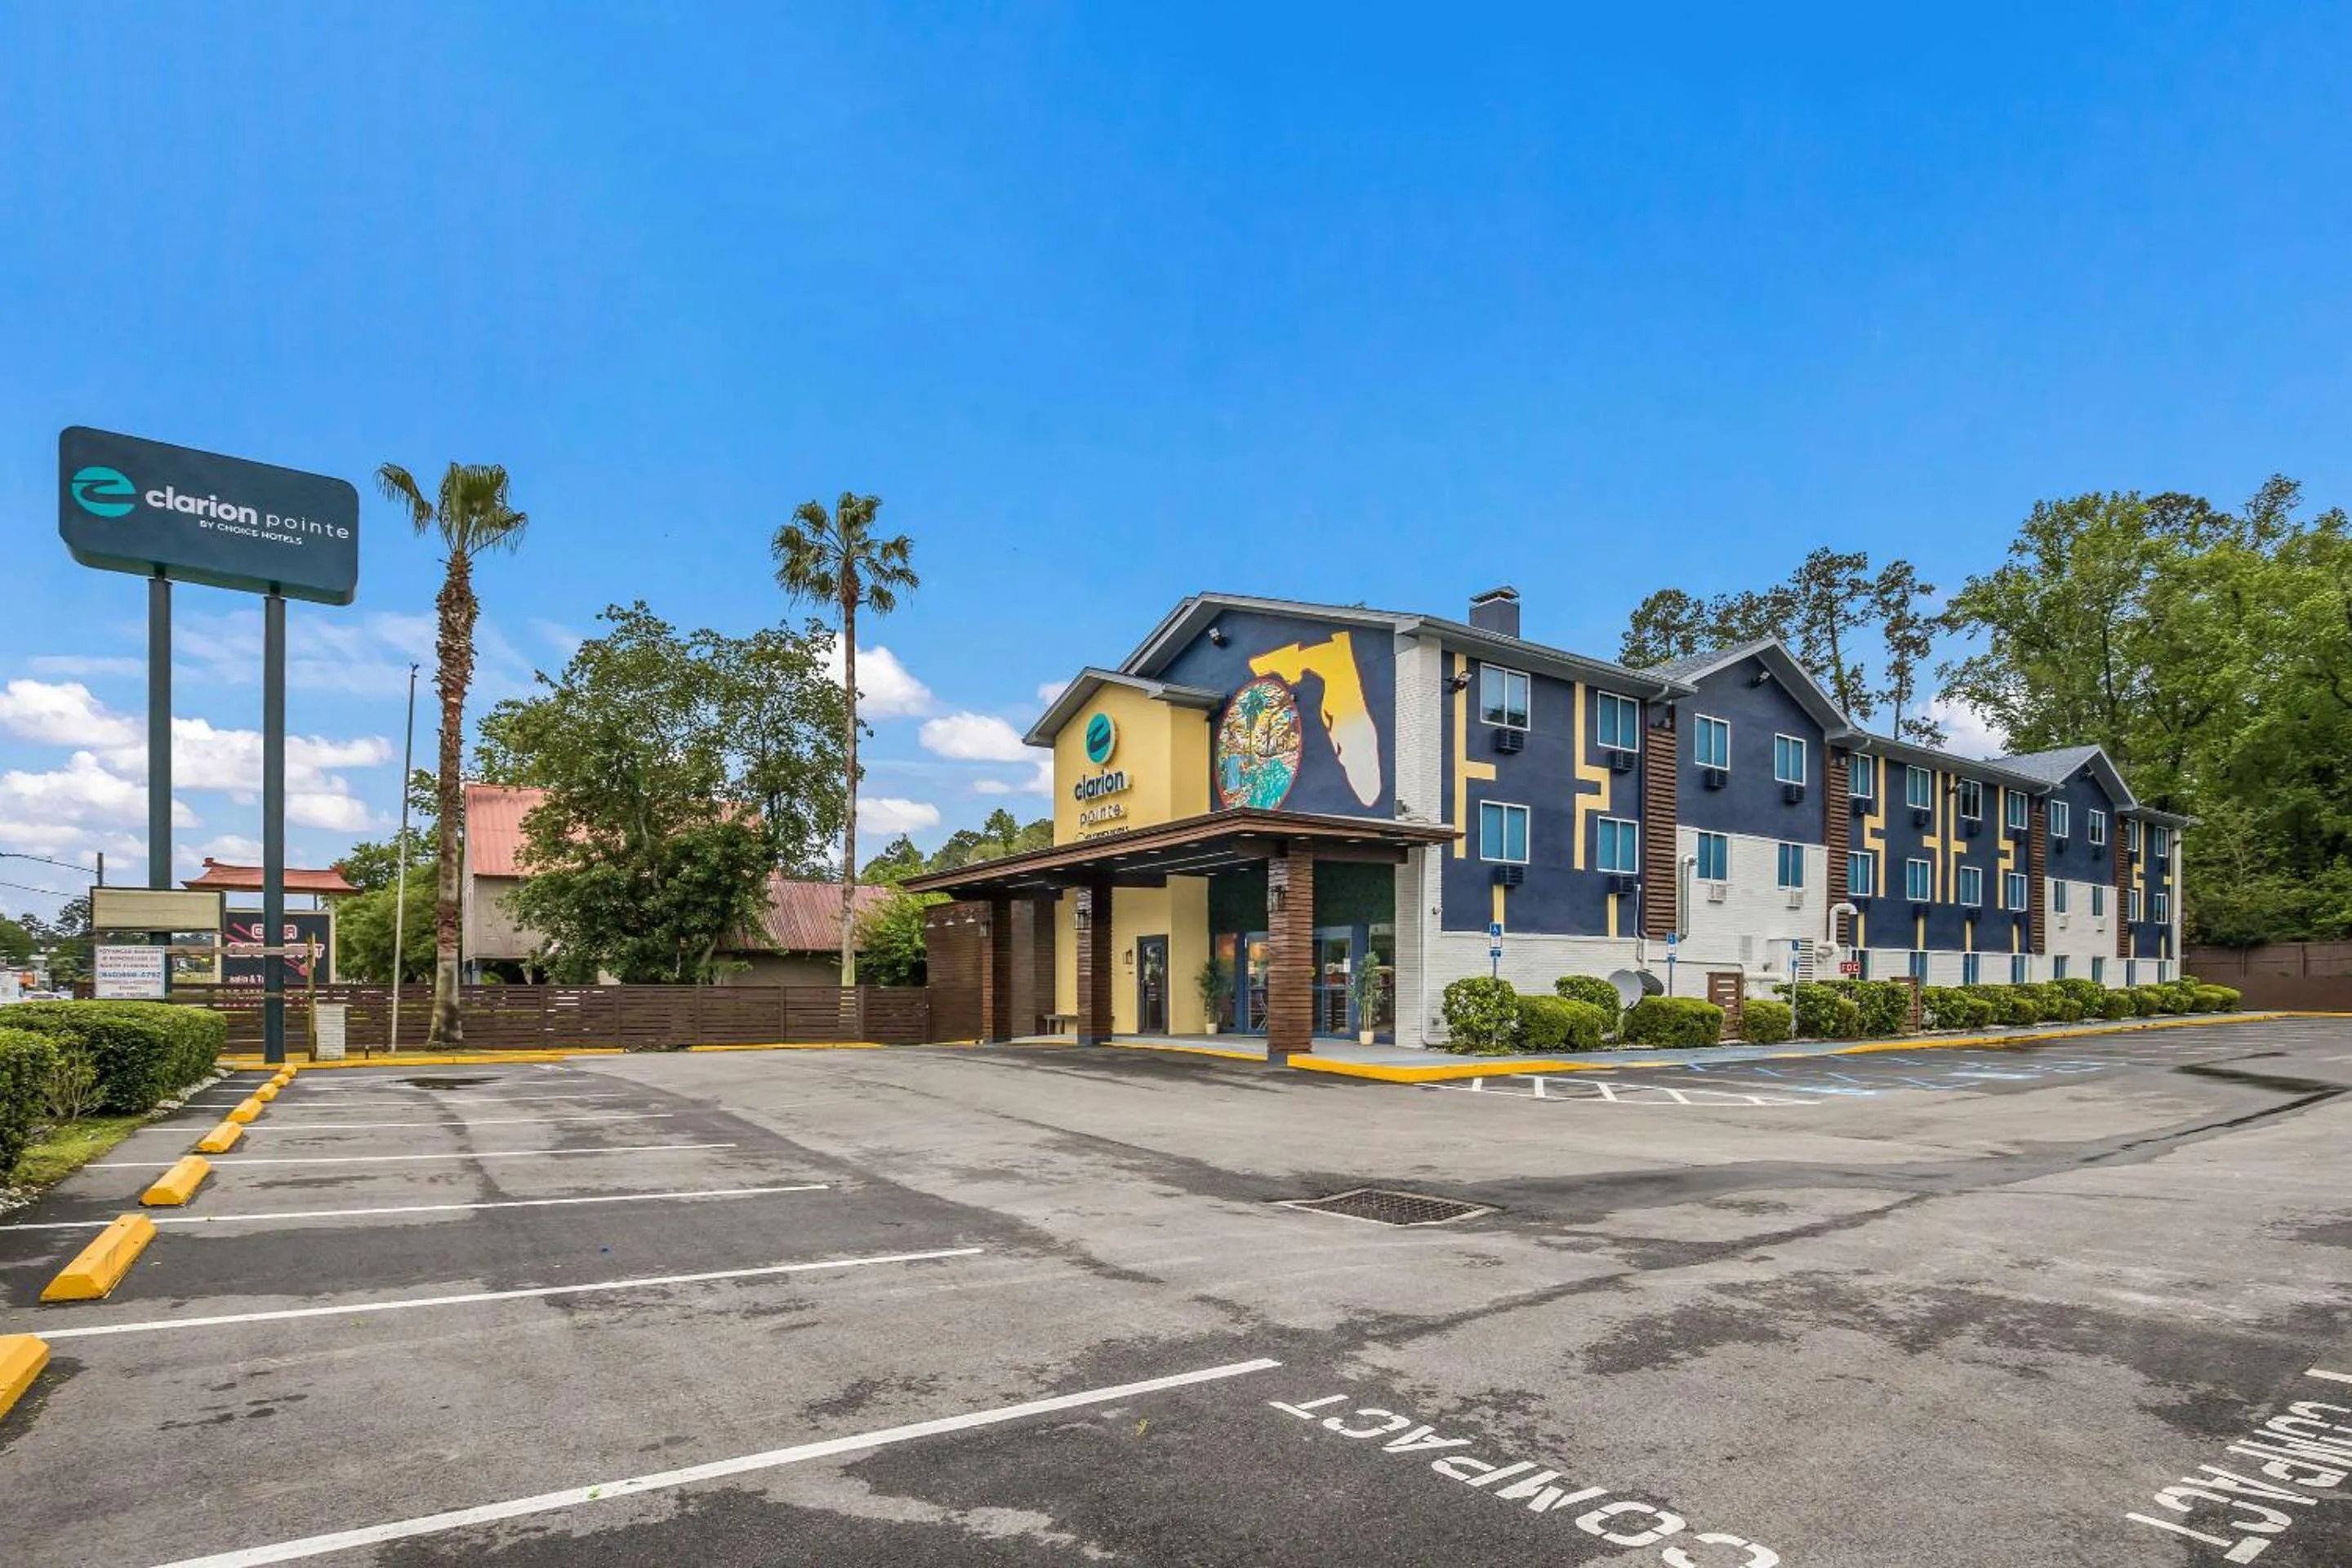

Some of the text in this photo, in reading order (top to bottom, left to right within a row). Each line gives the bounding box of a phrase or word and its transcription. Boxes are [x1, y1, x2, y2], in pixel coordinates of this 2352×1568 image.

[145, 485, 350, 539] clarion pointe
[199, 519, 302, 545] BY CHOICE HOTELS
[1075, 769, 1124, 801] clarion
[1080, 804, 1122, 827] pointe
[1268, 1394, 1780, 1568] COMPACT
